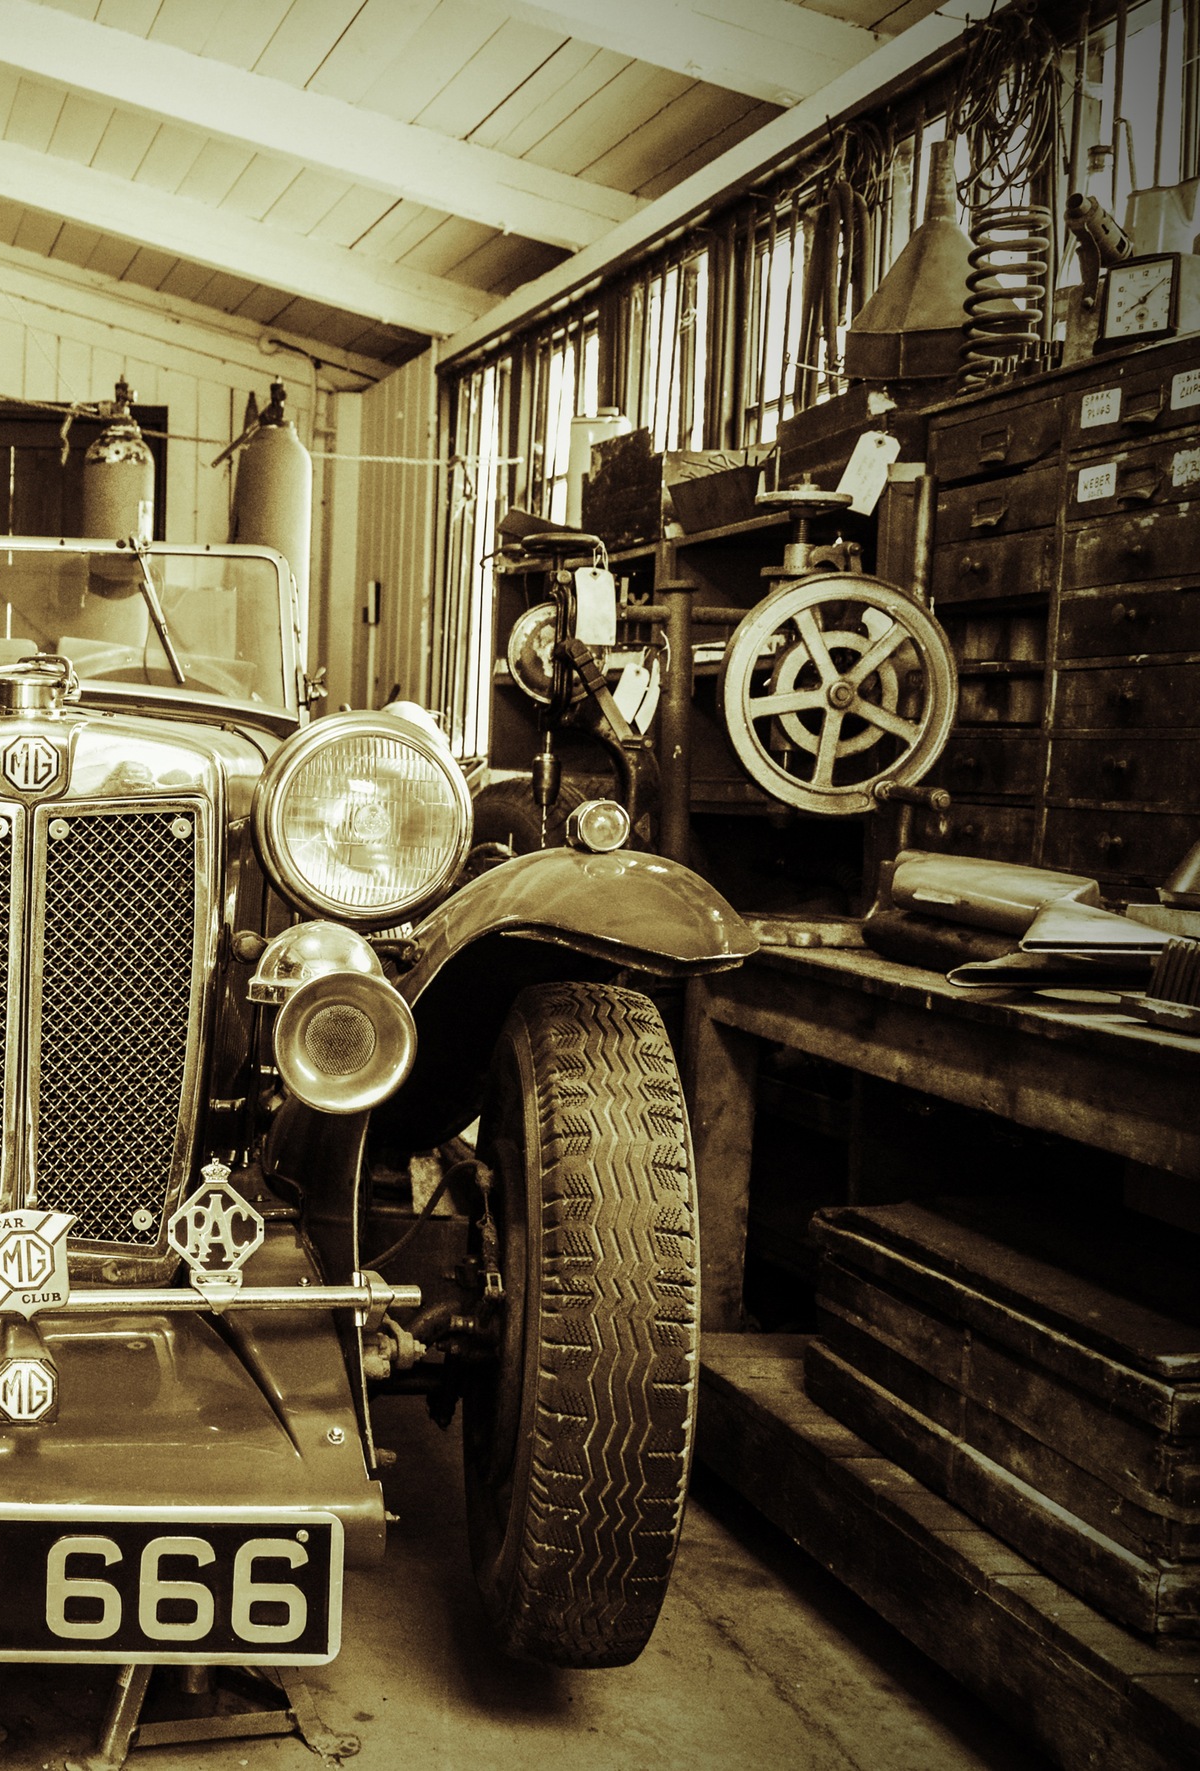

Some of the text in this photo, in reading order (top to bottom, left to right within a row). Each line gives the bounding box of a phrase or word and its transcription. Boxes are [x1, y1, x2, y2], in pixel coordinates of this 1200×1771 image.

[1085, 391, 1112, 407] SPARK
[1082, 473, 1111, 491] WEBER
[9, 743, 57, 786] MG
[186, 1193, 250, 1263] RAC
[0, 1238, 49, 1284] MG
[21, 1291, 62, 1305] CLUB
[1, 1366, 53, 1414] MG
[45, 1535, 309, 1643] 666
